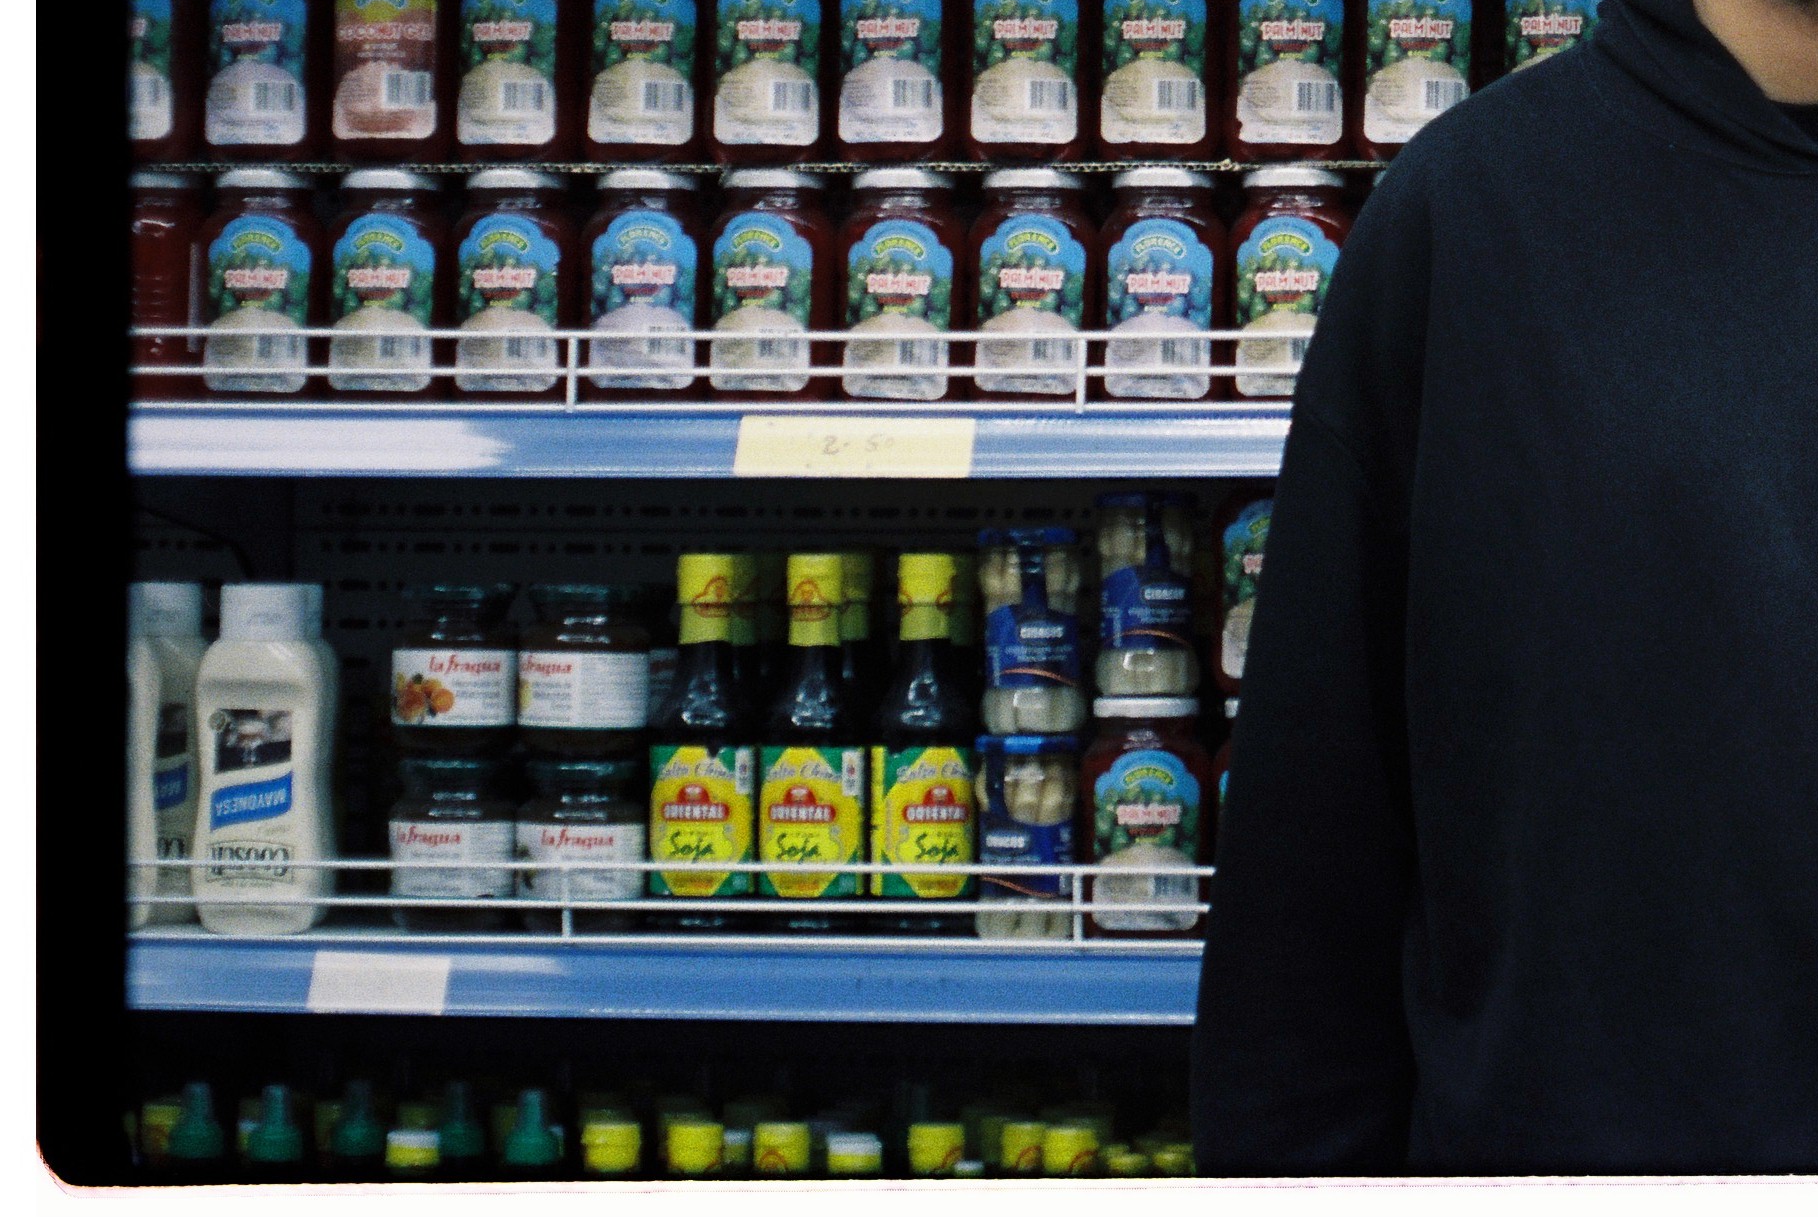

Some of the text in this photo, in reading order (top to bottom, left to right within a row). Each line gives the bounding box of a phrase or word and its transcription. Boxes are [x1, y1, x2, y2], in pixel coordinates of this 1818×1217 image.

[1262, 20, 1323, 40] PALM NUT
[1390, 18, 1451, 38] PALM NUT
[1521, 16, 1581, 35] PALM NUT
[444, 654, 500, 674] fragua
[214, 788, 287, 816] MAYONESA
[406, 826, 461, 847] fragua
[555, 828, 614, 849] fragua
[670, 831, 714, 864] Soja
[776, 831, 821, 864] Soja
[916, 832, 959, 864] Soja
